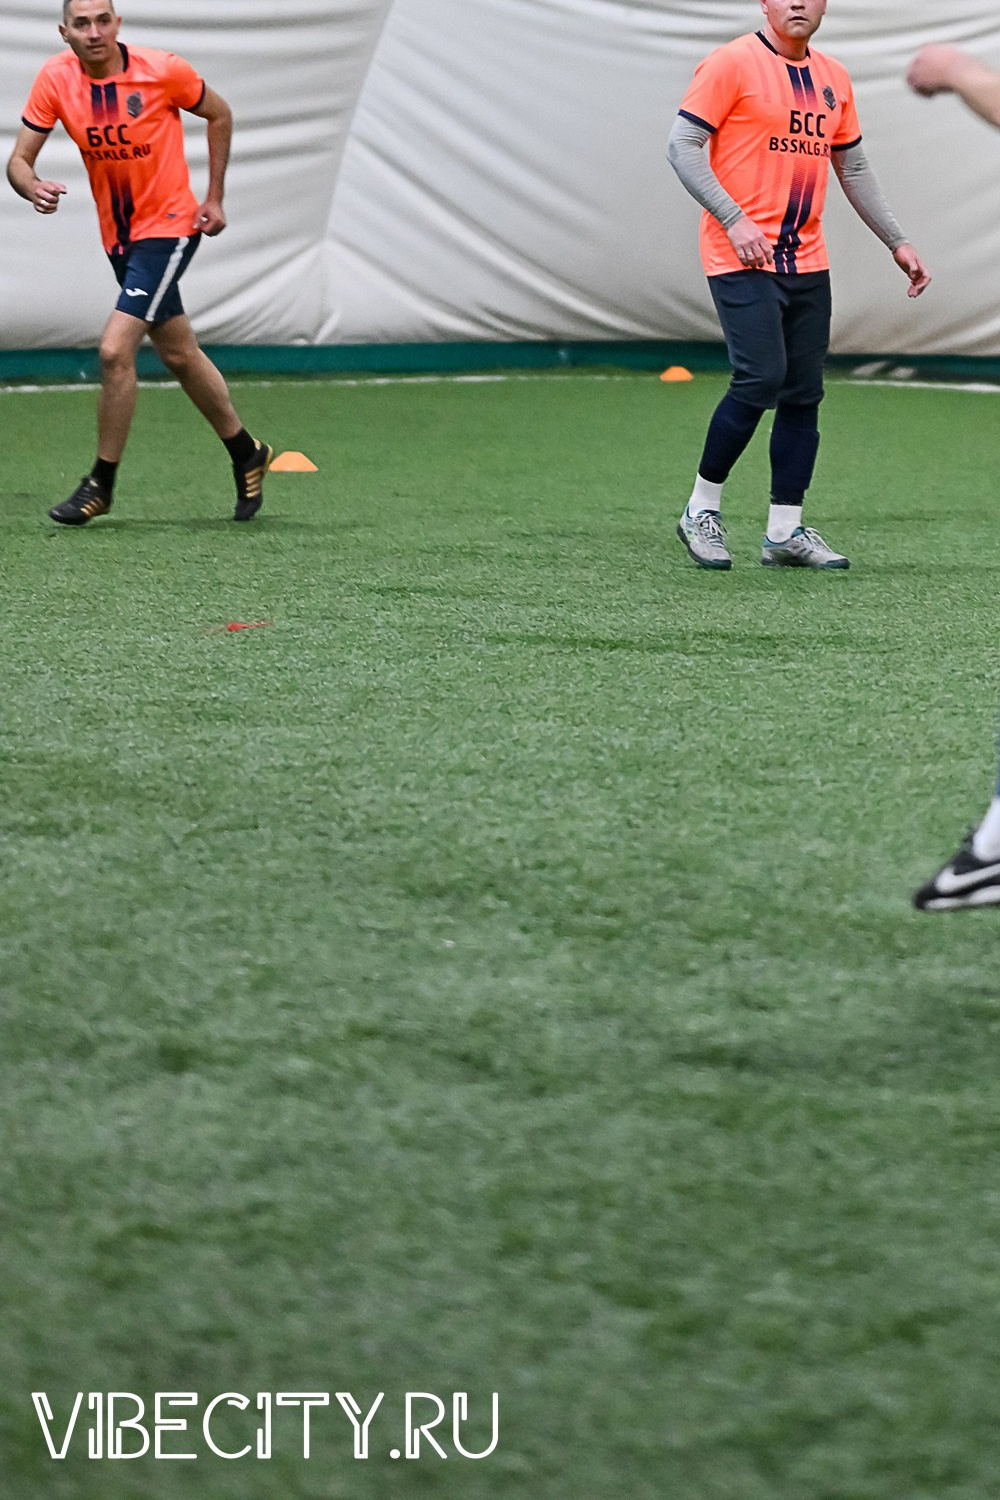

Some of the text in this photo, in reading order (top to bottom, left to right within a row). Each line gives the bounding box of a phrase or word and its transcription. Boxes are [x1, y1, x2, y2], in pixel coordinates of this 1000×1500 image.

[86, 124, 132, 147] БСС
[789, 110, 827, 138] БСС
[769, 136, 831, 158] BSSKLG.R
